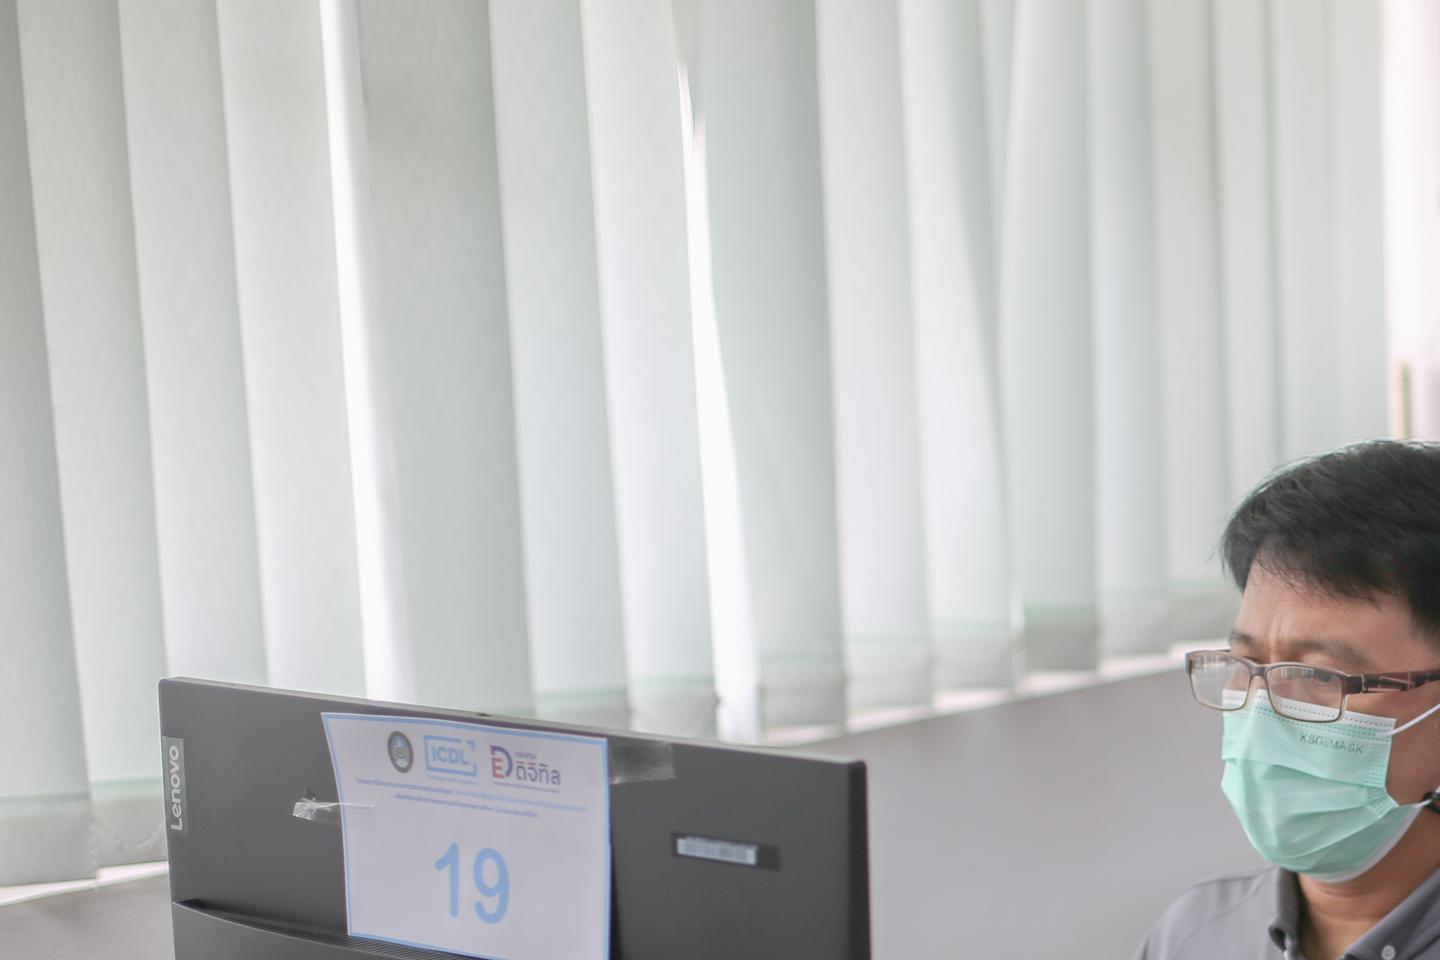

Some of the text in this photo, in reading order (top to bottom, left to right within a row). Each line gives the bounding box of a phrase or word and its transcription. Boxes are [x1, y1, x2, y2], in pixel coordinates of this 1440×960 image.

[168, 745, 184, 831] Lenovo
[432, 746, 469, 765] ICDL
[434, 842, 510, 925] 19
